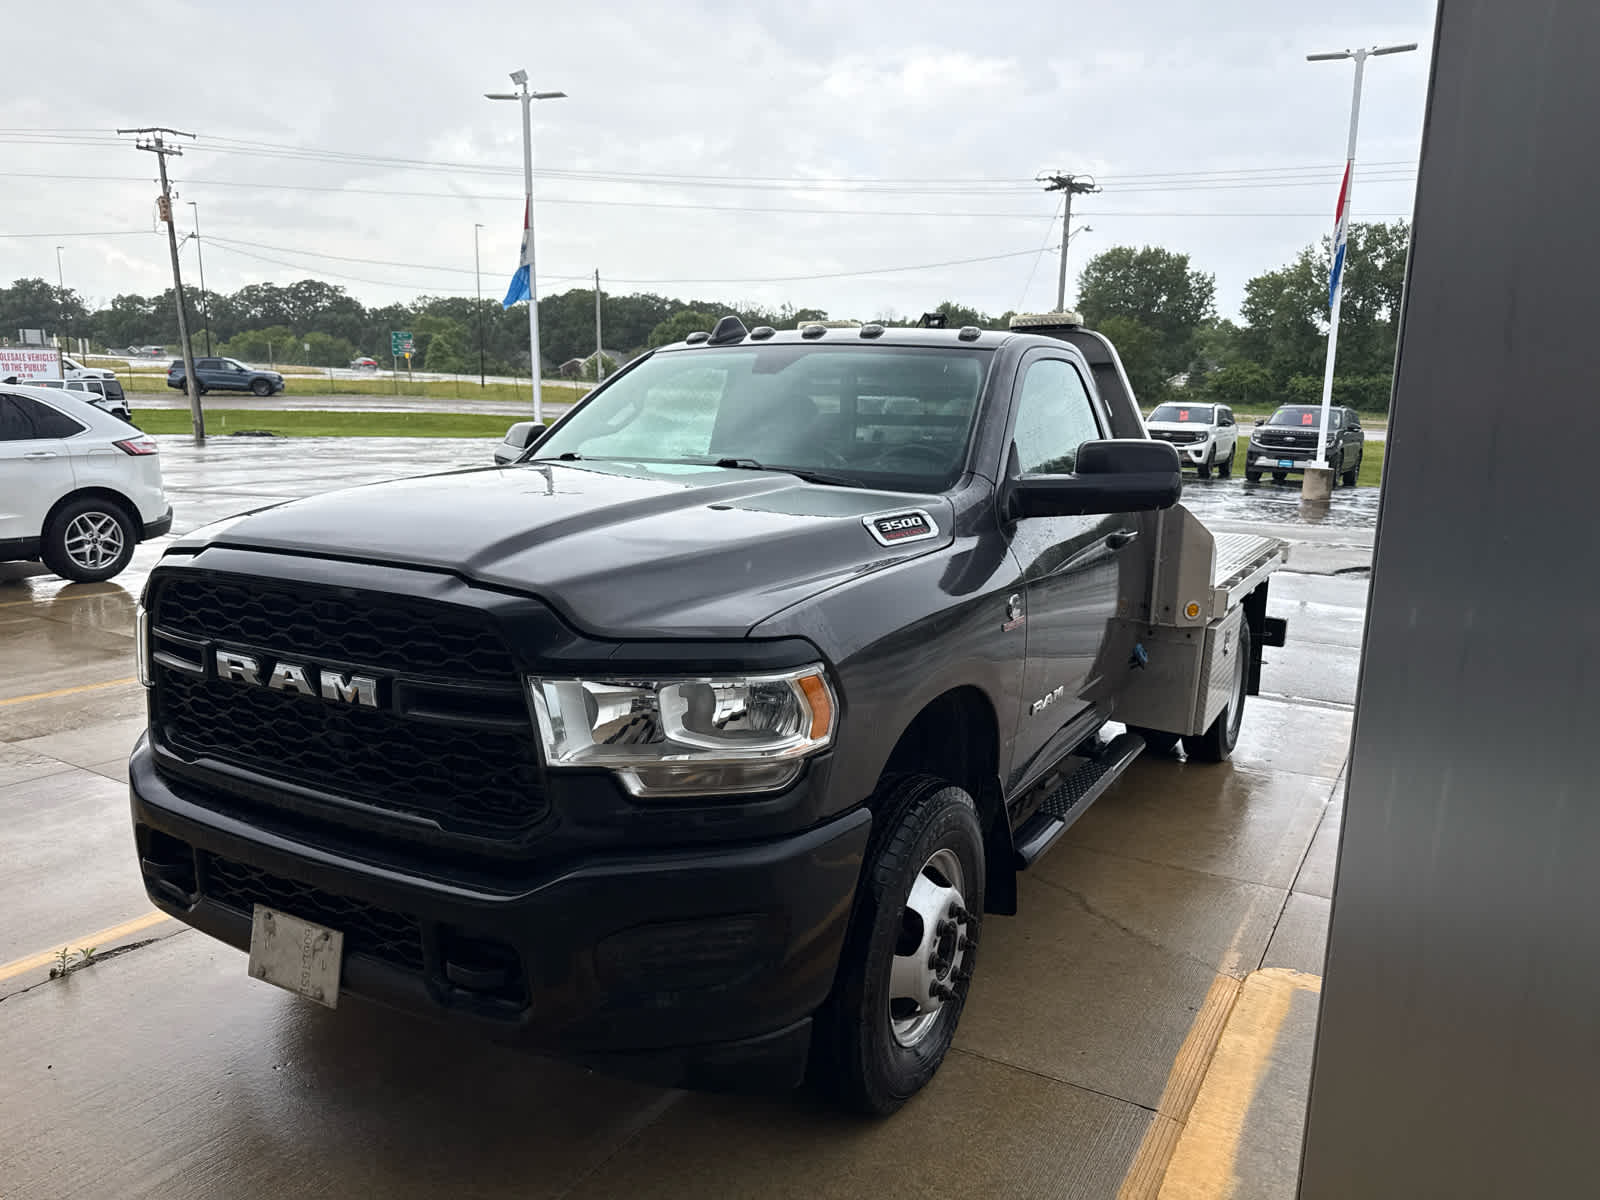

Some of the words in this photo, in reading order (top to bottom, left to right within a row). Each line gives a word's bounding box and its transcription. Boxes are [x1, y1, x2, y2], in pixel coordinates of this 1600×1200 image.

[27, 353, 57, 362] VEHICLES
[1, 363, 10, 372] TO
[10, 363, 23, 372] THE
[24, 363, 47, 373] PUBLIC
[880, 516, 922, 532] 3500
[216, 650, 378, 709] RAM
[1031, 685, 1064, 715] RAM
